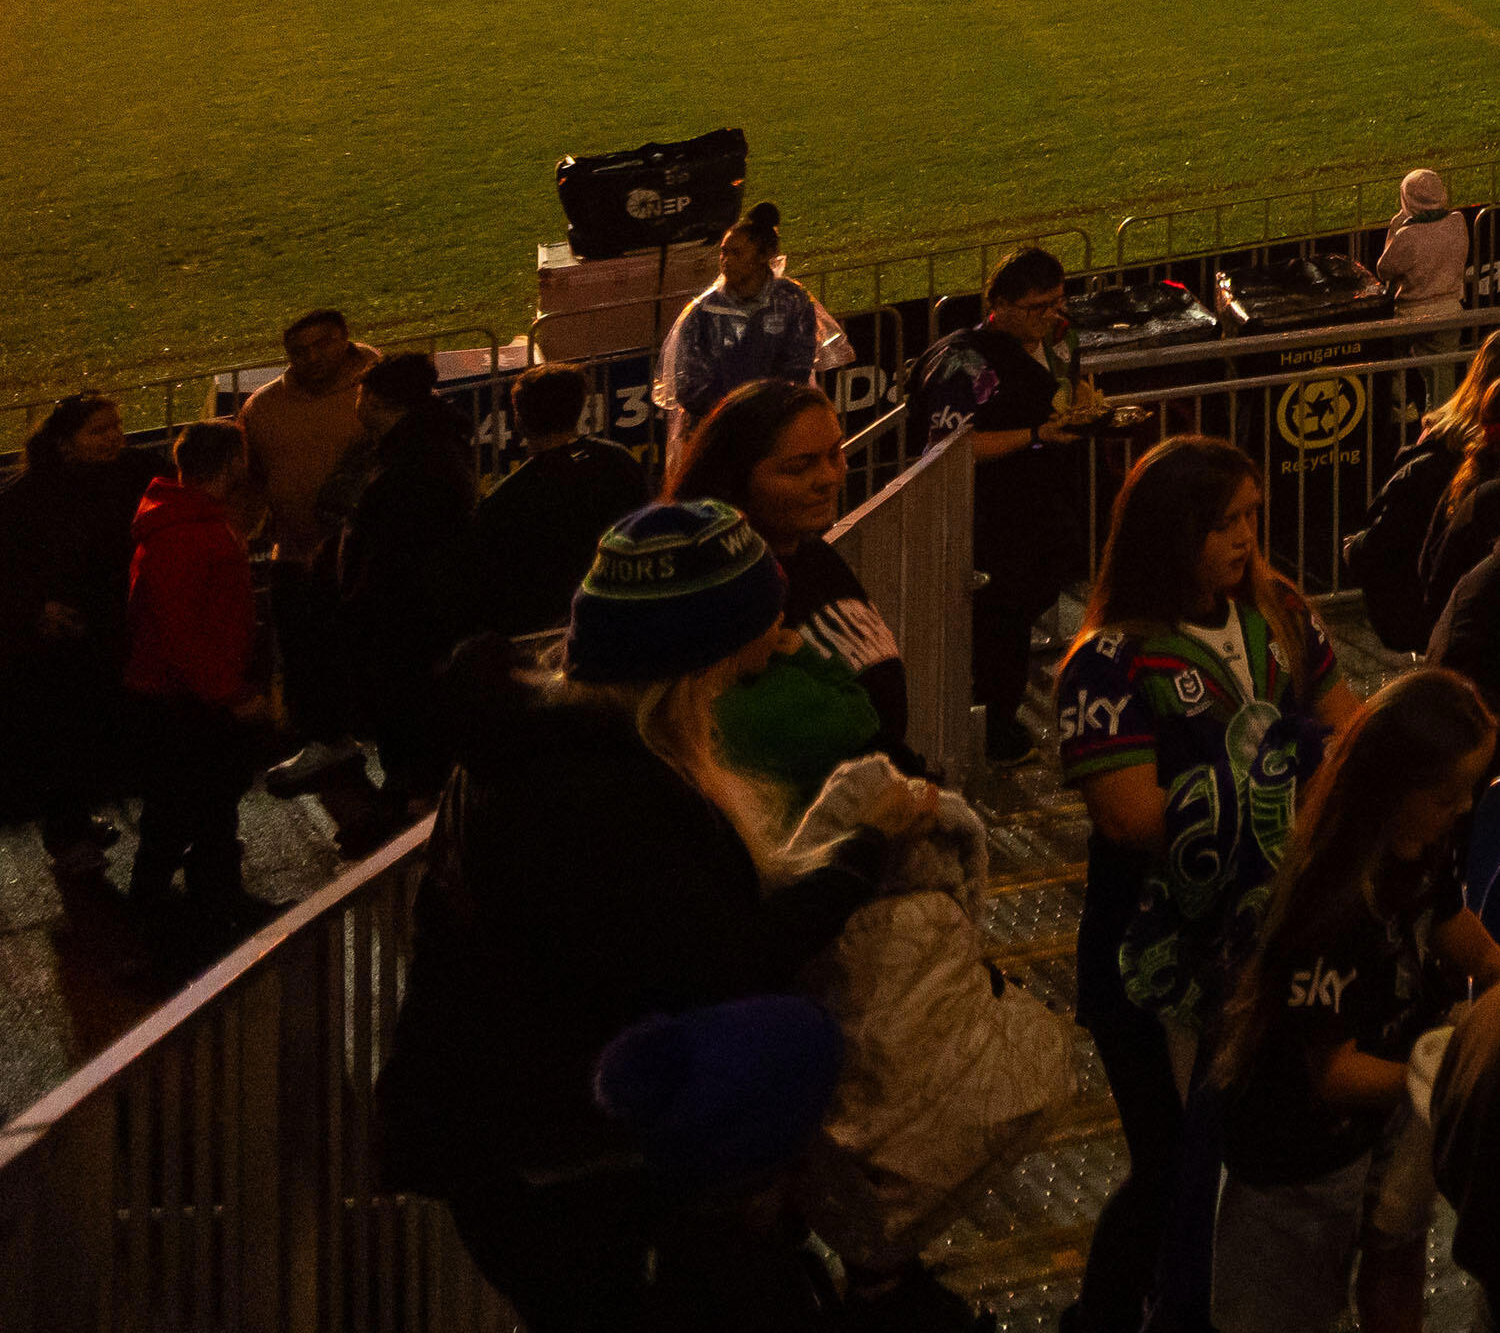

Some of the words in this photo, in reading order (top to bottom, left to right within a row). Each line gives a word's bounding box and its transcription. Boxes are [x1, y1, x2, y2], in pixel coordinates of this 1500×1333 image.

[1279, 341, 1363, 367] Hangarua
[931, 404, 976, 434] sky
[1281, 447, 1363, 475] Recycling
[1057, 688, 1134, 740] sky
[1286, 956, 1359, 1015] sky
